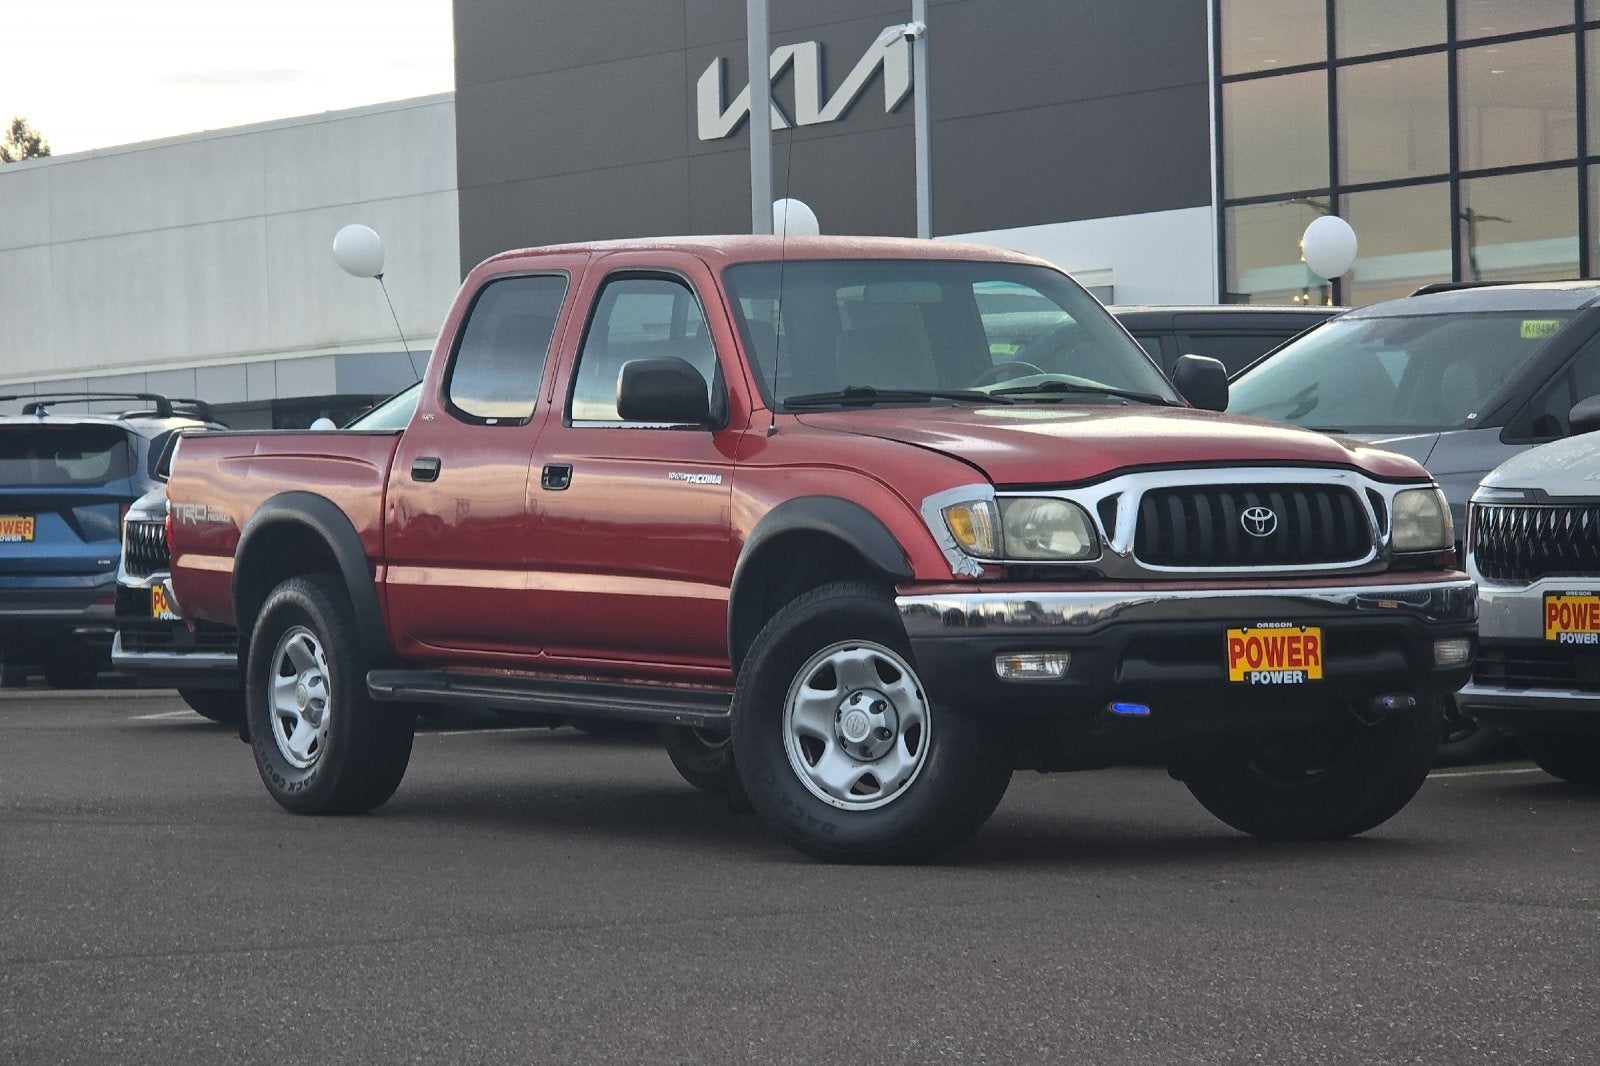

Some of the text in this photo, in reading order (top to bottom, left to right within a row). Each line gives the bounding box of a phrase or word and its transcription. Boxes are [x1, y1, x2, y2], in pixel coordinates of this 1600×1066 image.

[686, 473, 721, 484] TACOMA
[172, 503, 207, 525] TRD
[0, 520, 32, 534] WER
[1560, 633, 1599, 644] POWER
[1229, 635, 1320, 669] POWER
[1251, 670, 1303, 685] POWER
